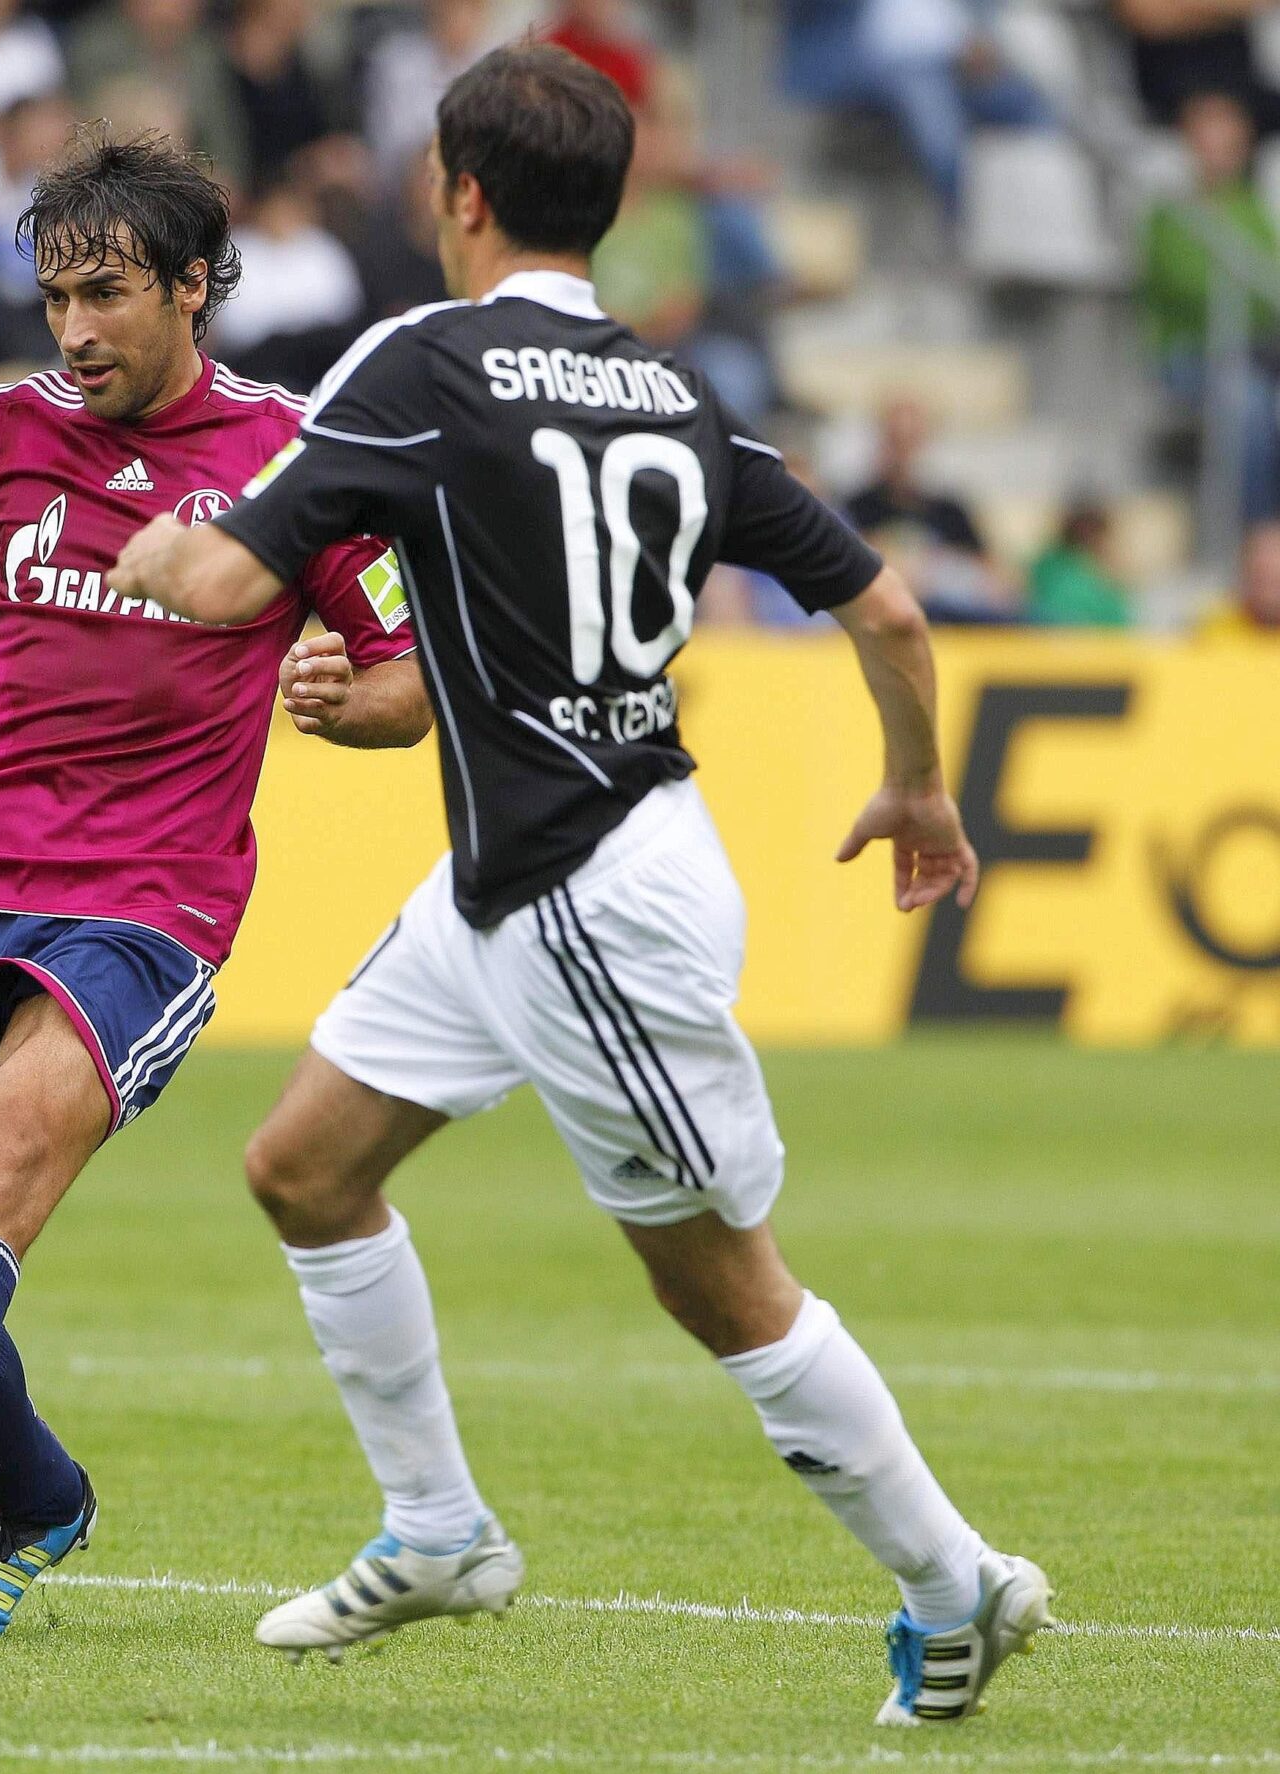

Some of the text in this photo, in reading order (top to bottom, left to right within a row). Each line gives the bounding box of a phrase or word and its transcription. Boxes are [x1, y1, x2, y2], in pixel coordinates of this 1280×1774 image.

[105, 479, 154, 492] adidas
[531, 426, 708, 686] 10
[910, 680, 1134, 1030] E
